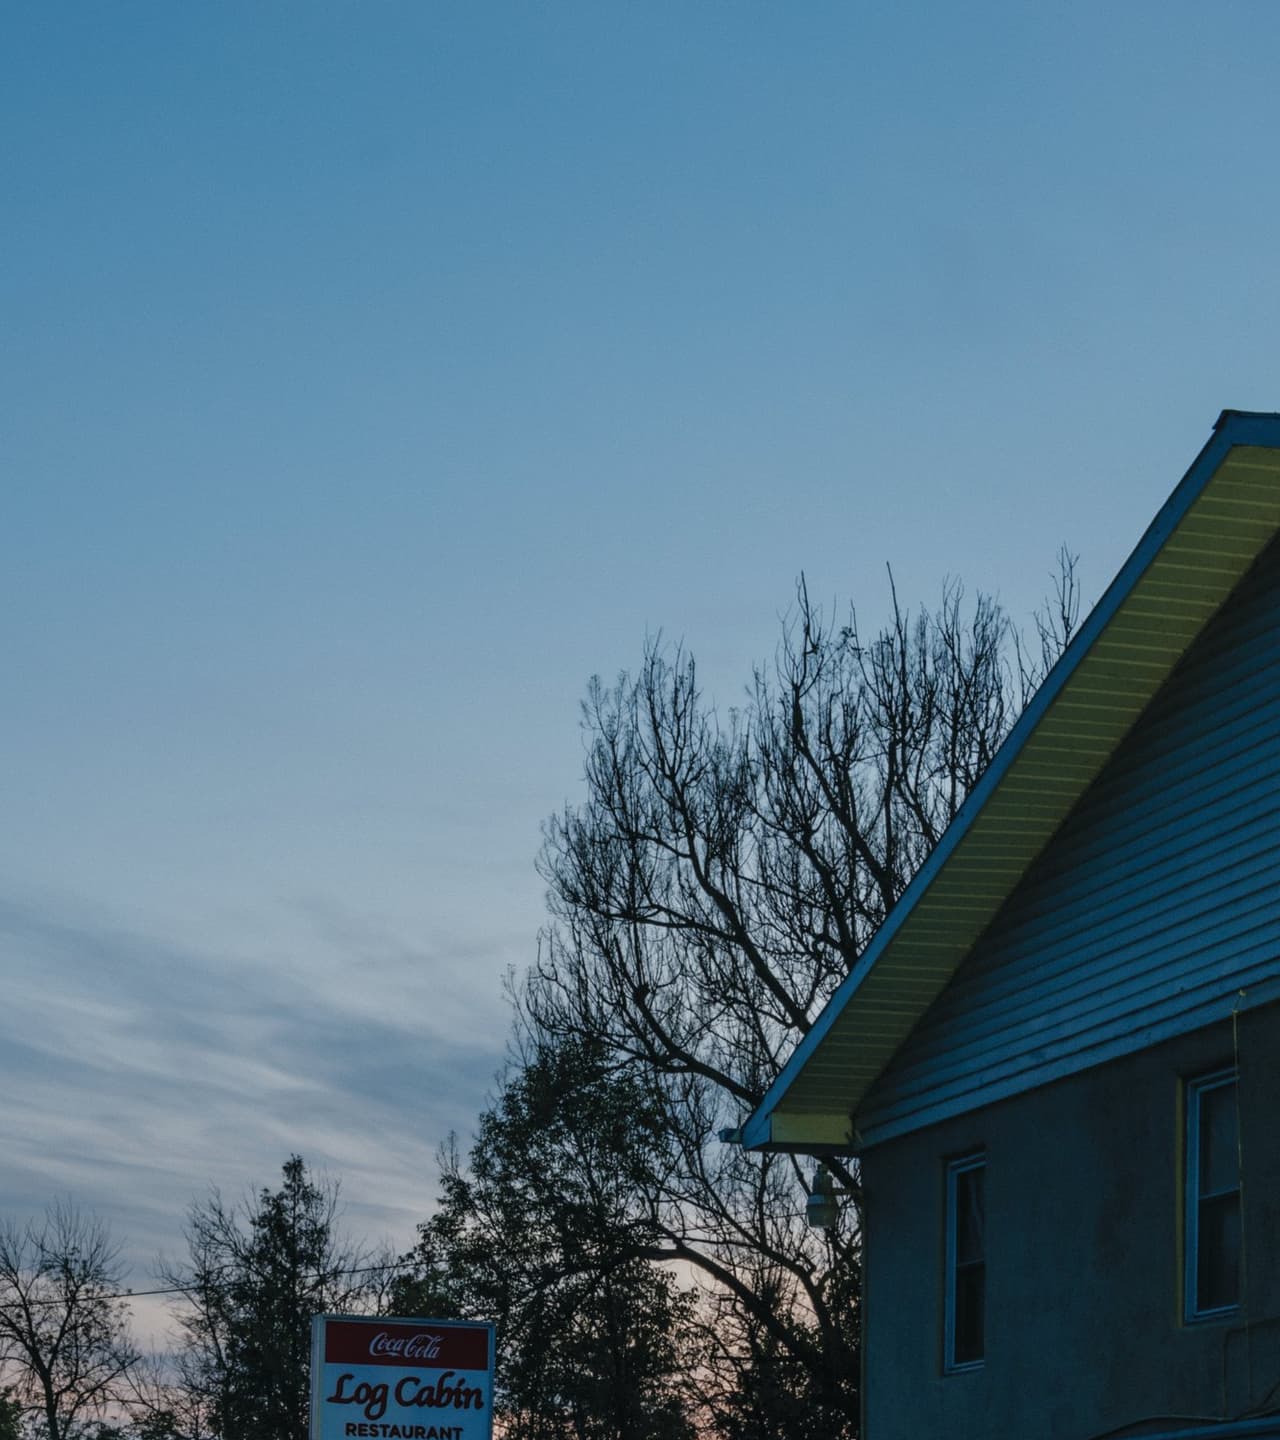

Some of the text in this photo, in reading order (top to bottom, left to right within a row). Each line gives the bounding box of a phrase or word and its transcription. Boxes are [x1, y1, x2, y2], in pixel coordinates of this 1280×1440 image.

[327, 1371, 484, 1420] Log Cabin
[345, 1423, 463, 1440] RESTAURANT
